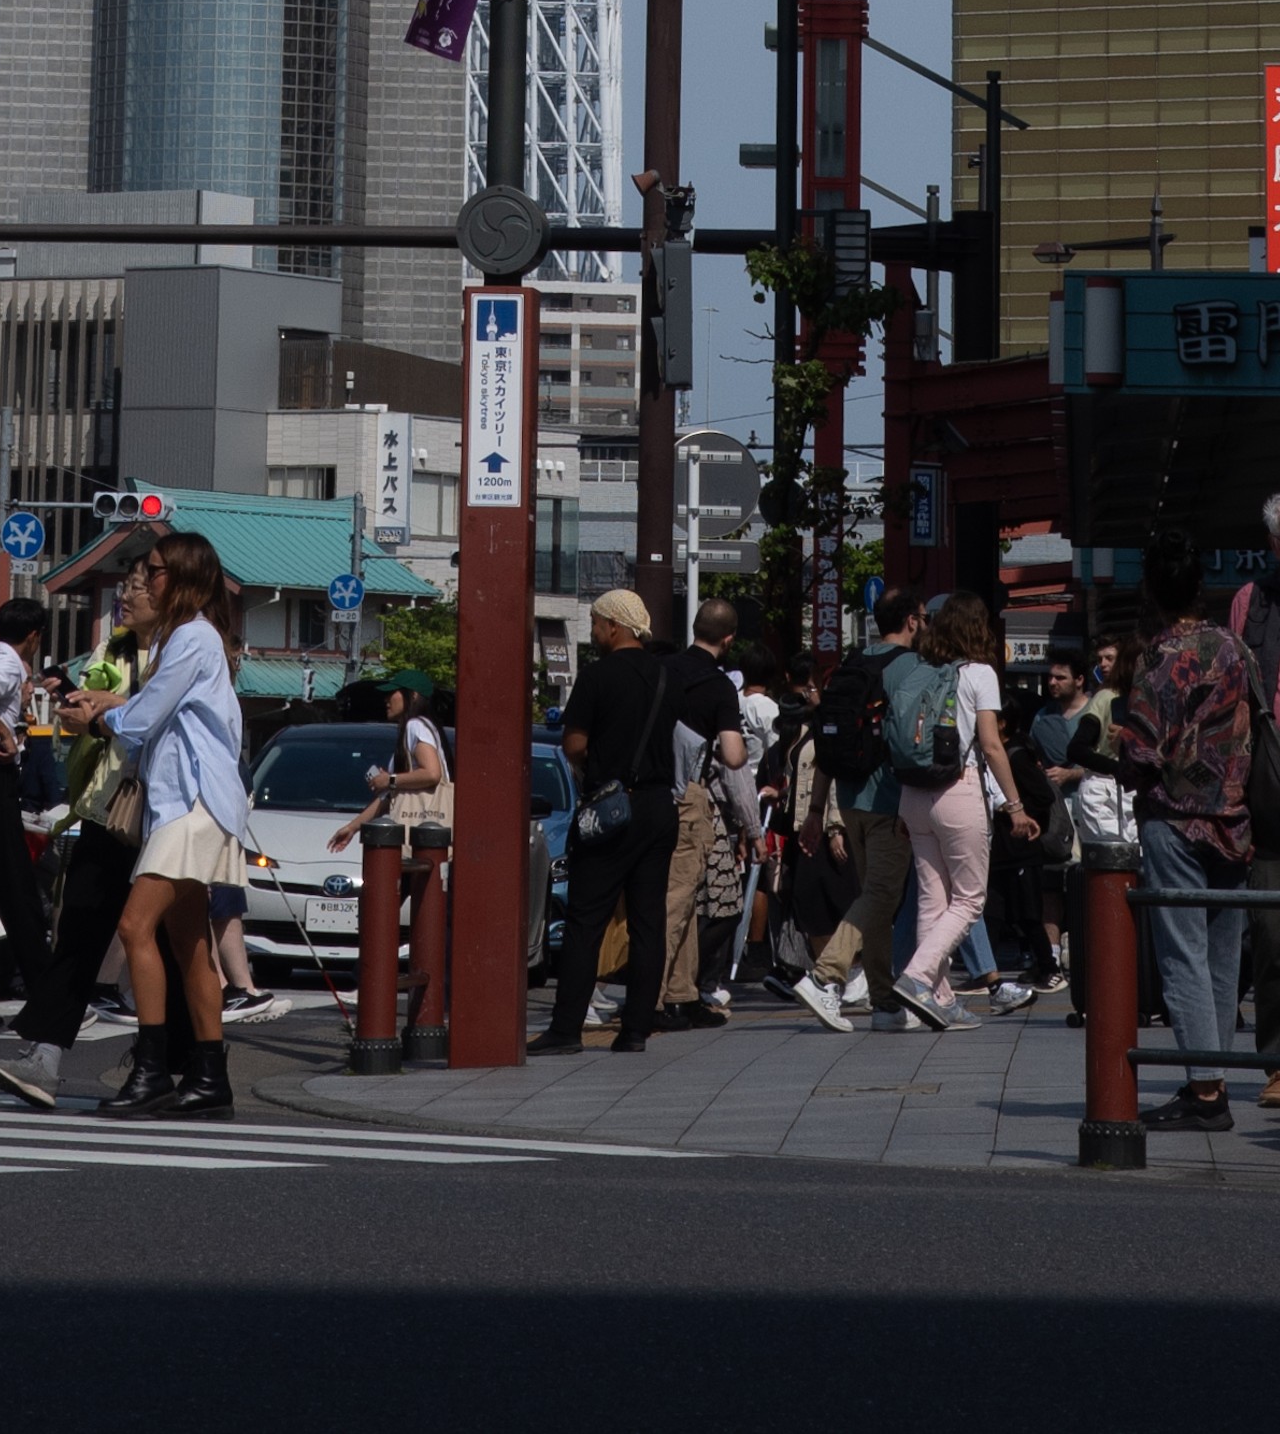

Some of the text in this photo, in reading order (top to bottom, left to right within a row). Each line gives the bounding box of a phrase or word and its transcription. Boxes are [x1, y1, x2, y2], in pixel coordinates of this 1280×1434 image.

[480, 353, 490, 386] Tokyo
[495, 347, 508, 447] 東京スカイツリー
[383, 430, 399, 515] 水上バス
[478, 478, 512, 487] 1200m
